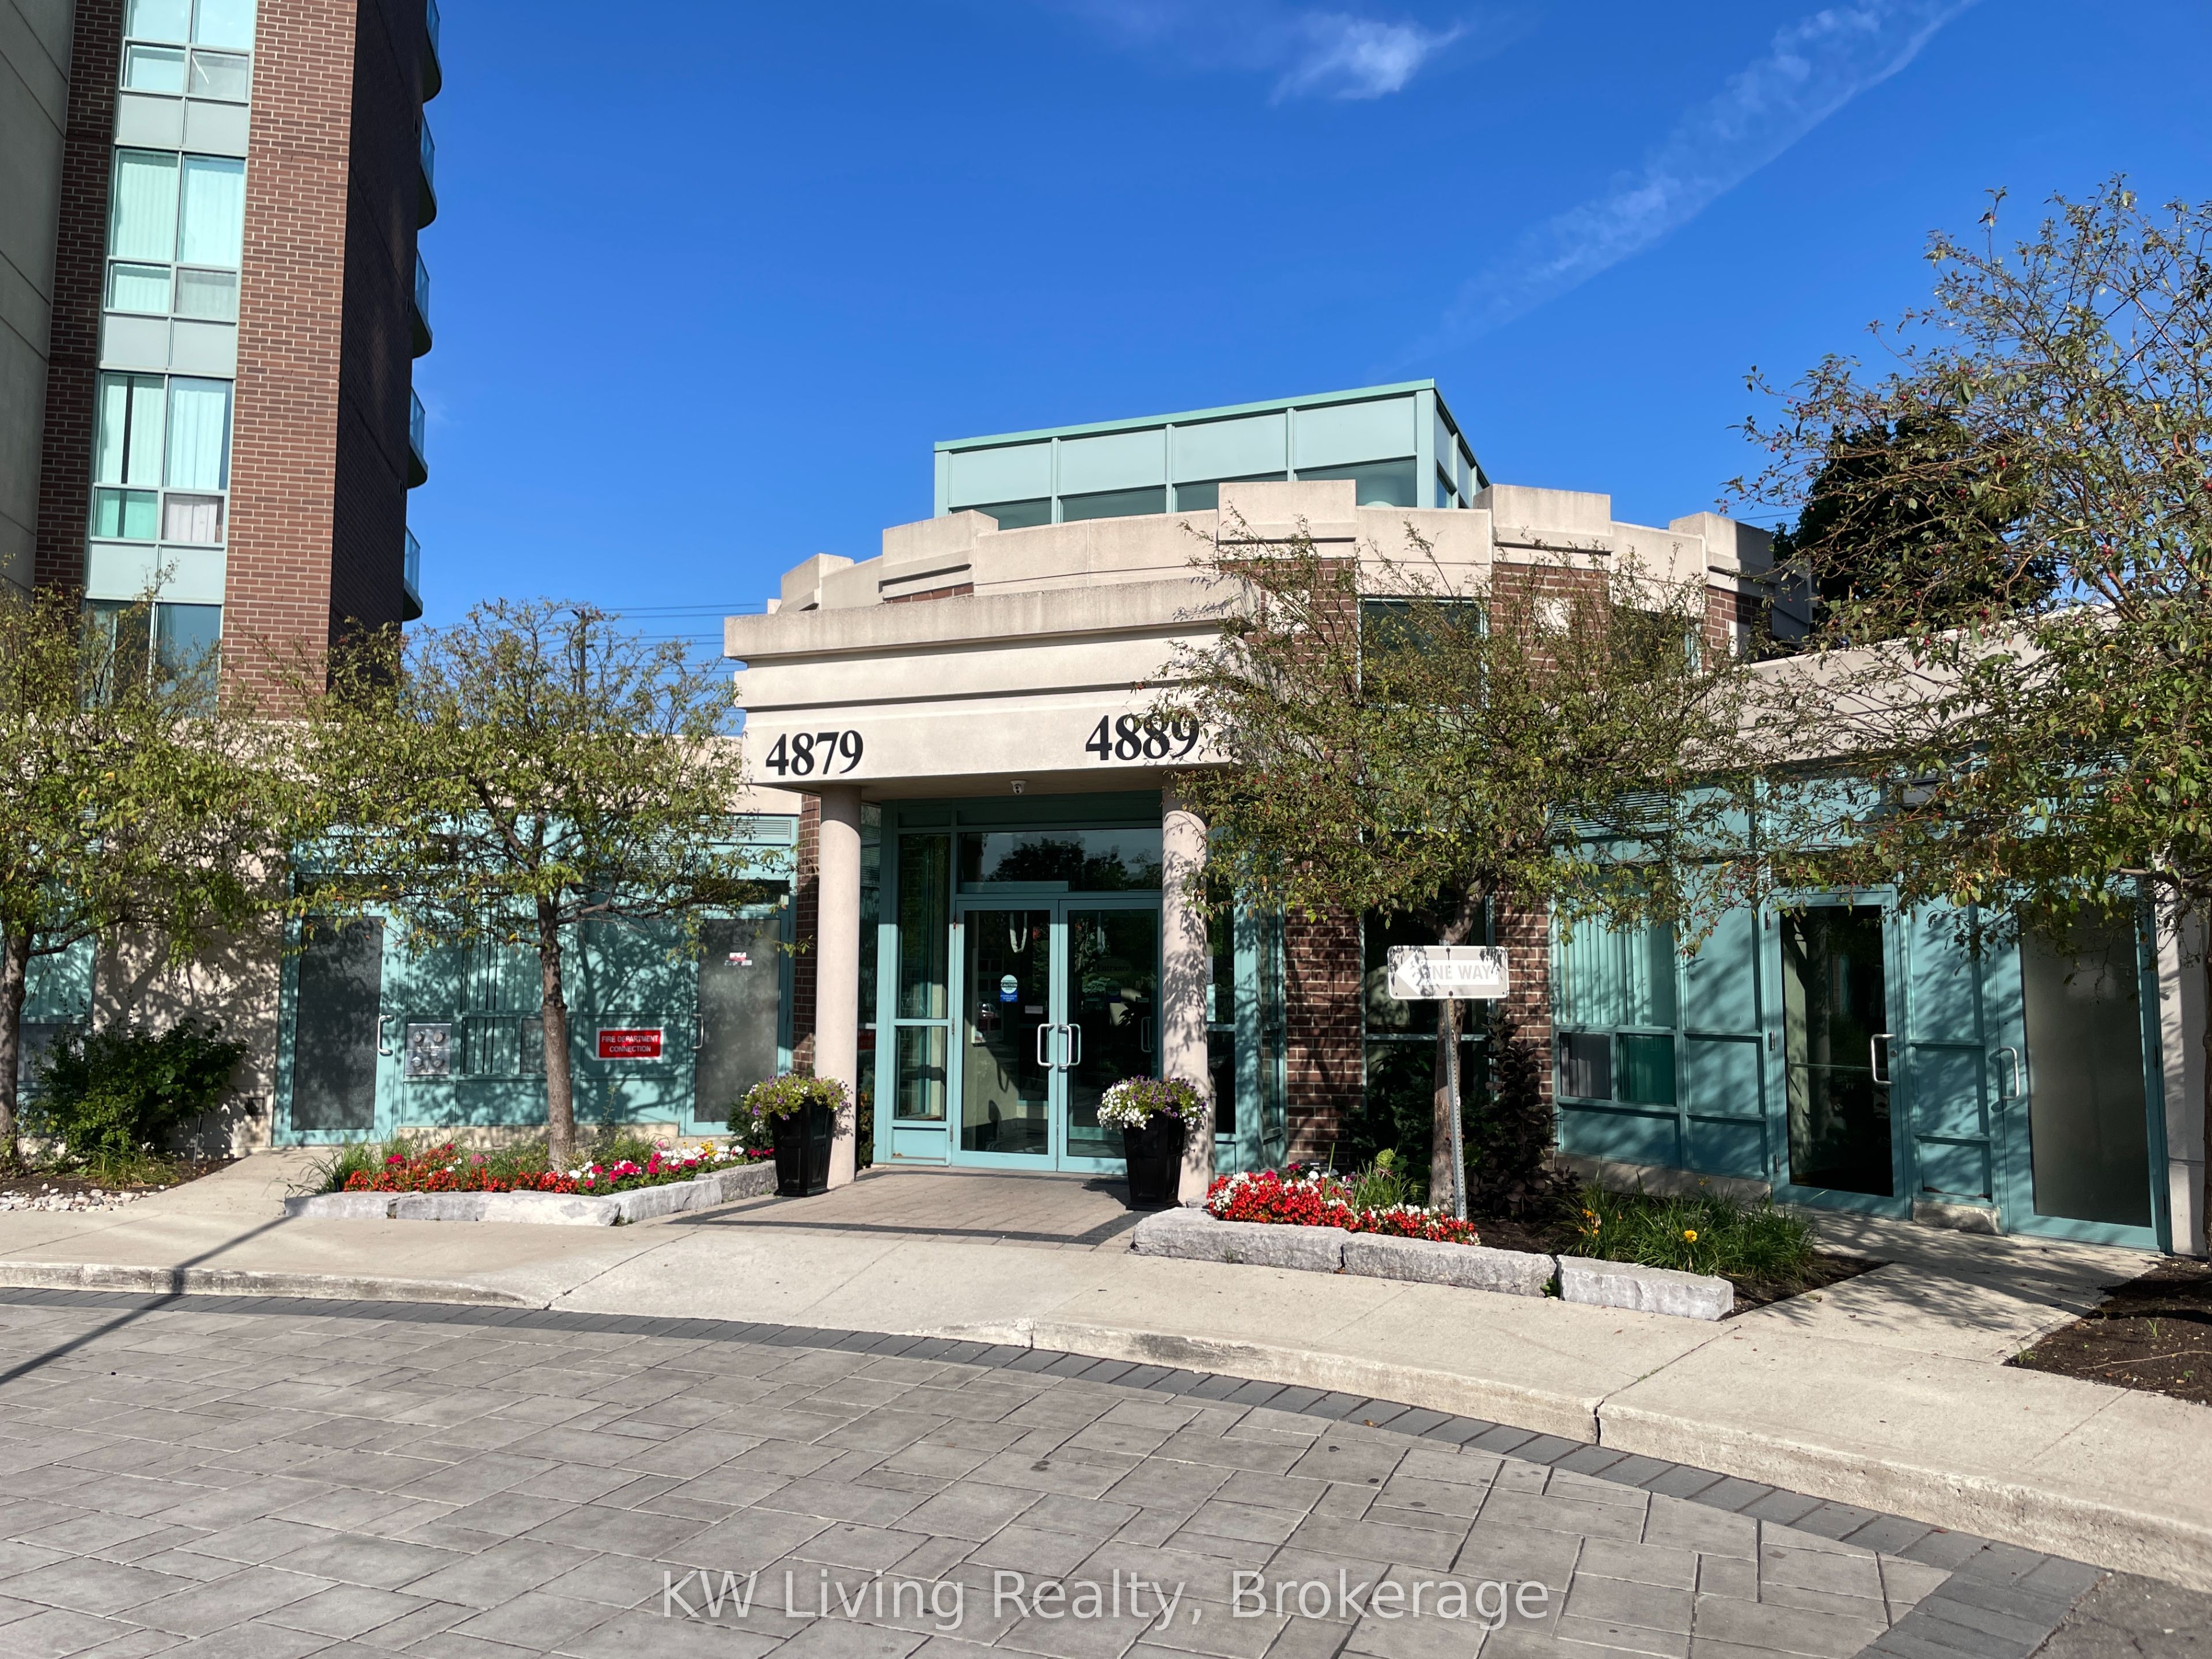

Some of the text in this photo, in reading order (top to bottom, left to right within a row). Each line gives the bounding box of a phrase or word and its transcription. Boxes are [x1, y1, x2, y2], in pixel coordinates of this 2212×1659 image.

[1085, 711, 1199, 761] 4889
[766, 730, 863, 776] 4879
[1097, 964, 1130, 972] Entrance
[1457, 965, 1491, 980] WAY
